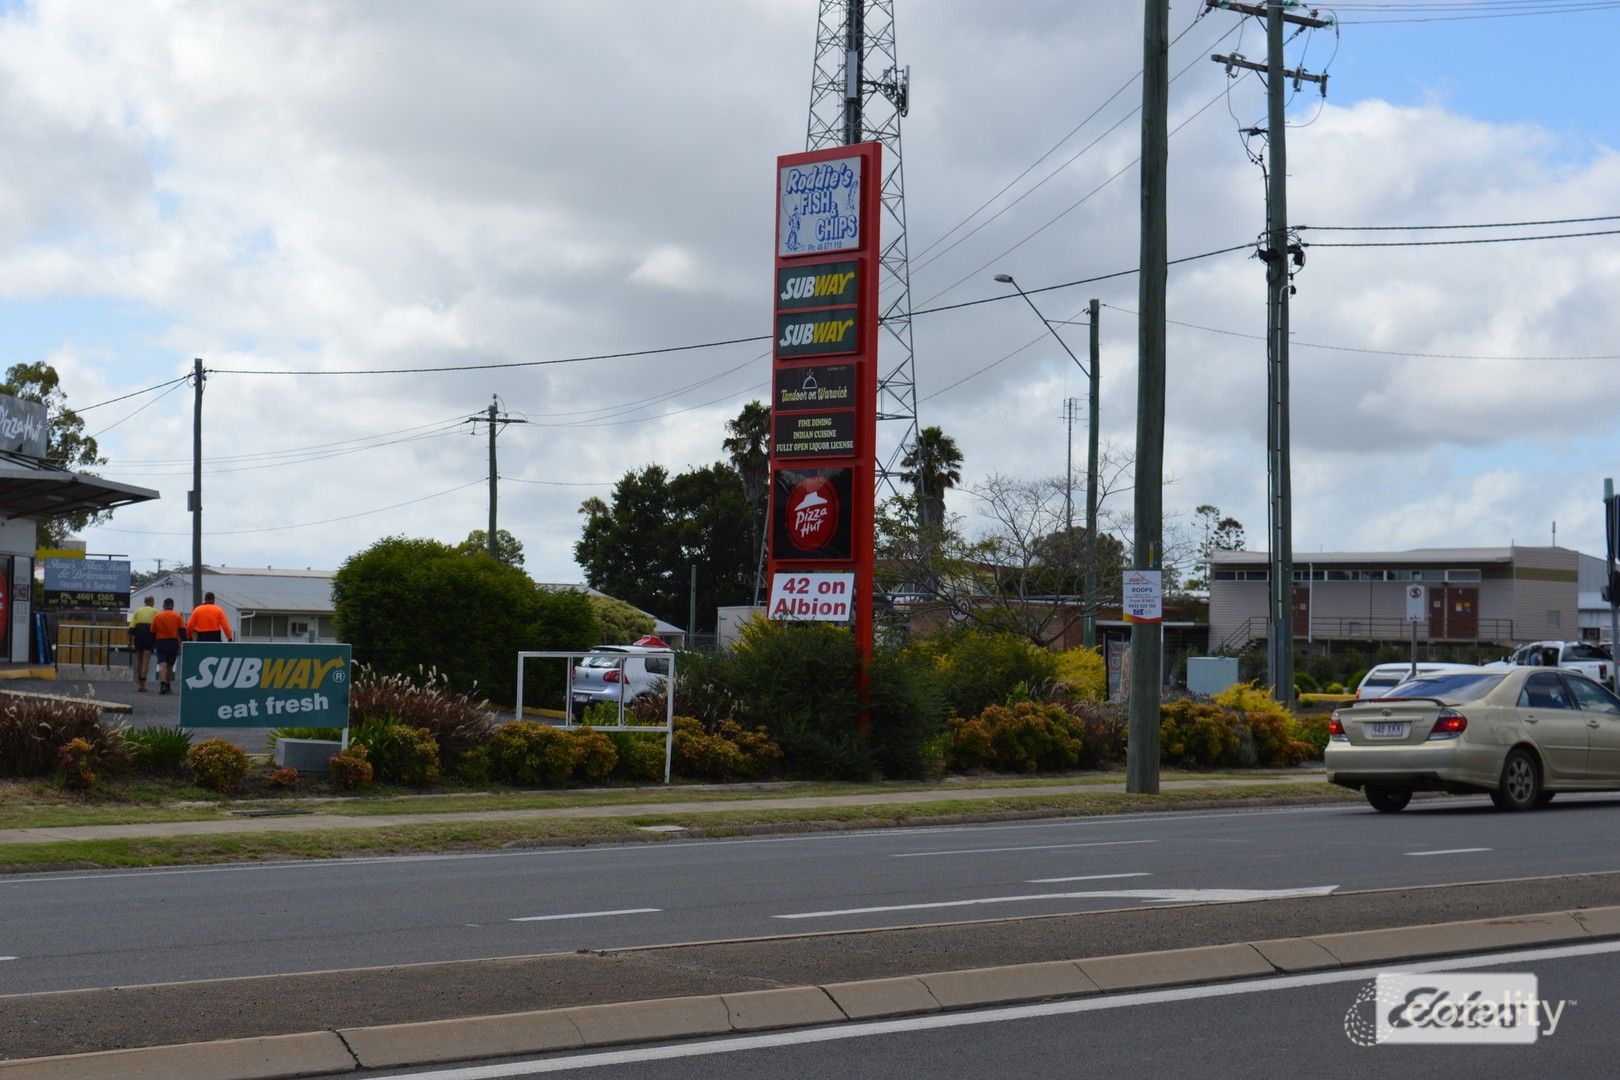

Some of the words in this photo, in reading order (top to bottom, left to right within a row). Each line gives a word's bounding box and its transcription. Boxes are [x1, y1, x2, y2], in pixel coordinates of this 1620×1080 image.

[786, 162, 854, 194] Roddie's
[801, 190, 832, 216] FISH
[829, 201, 839, 218] &
[815, 214, 858, 242] CHIPS
[780, 270, 856, 301] SUBWAY
[779, 317, 855, 348] SUBWAY
[24, 413, 43, 442] Hut
[793, 430, 814, 440] INDIAN
[814, 429, 837, 439] CUISINE
[798, 419, 811, 428] FINE
[811, 417, 832, 427] DINING
[776, 443, 793, 452] FULLY
[793, 442, 809, 451] OPEN
[809, 441, 831, 452] LIQUOR
[831, 440, 854, 450] LICENSE
[795, 507, 828, 530] Pizza
[801, 519, 824, 538] Hut
[783, 577, 811, 595] 42
[817, 580, 846, 595] on
[773, 598, 847, 616] Albion
[185, 656, 345, 690] SUBWAY
[217, 703, 259, 721] eat
[265, 692, 329, 716] fresh
